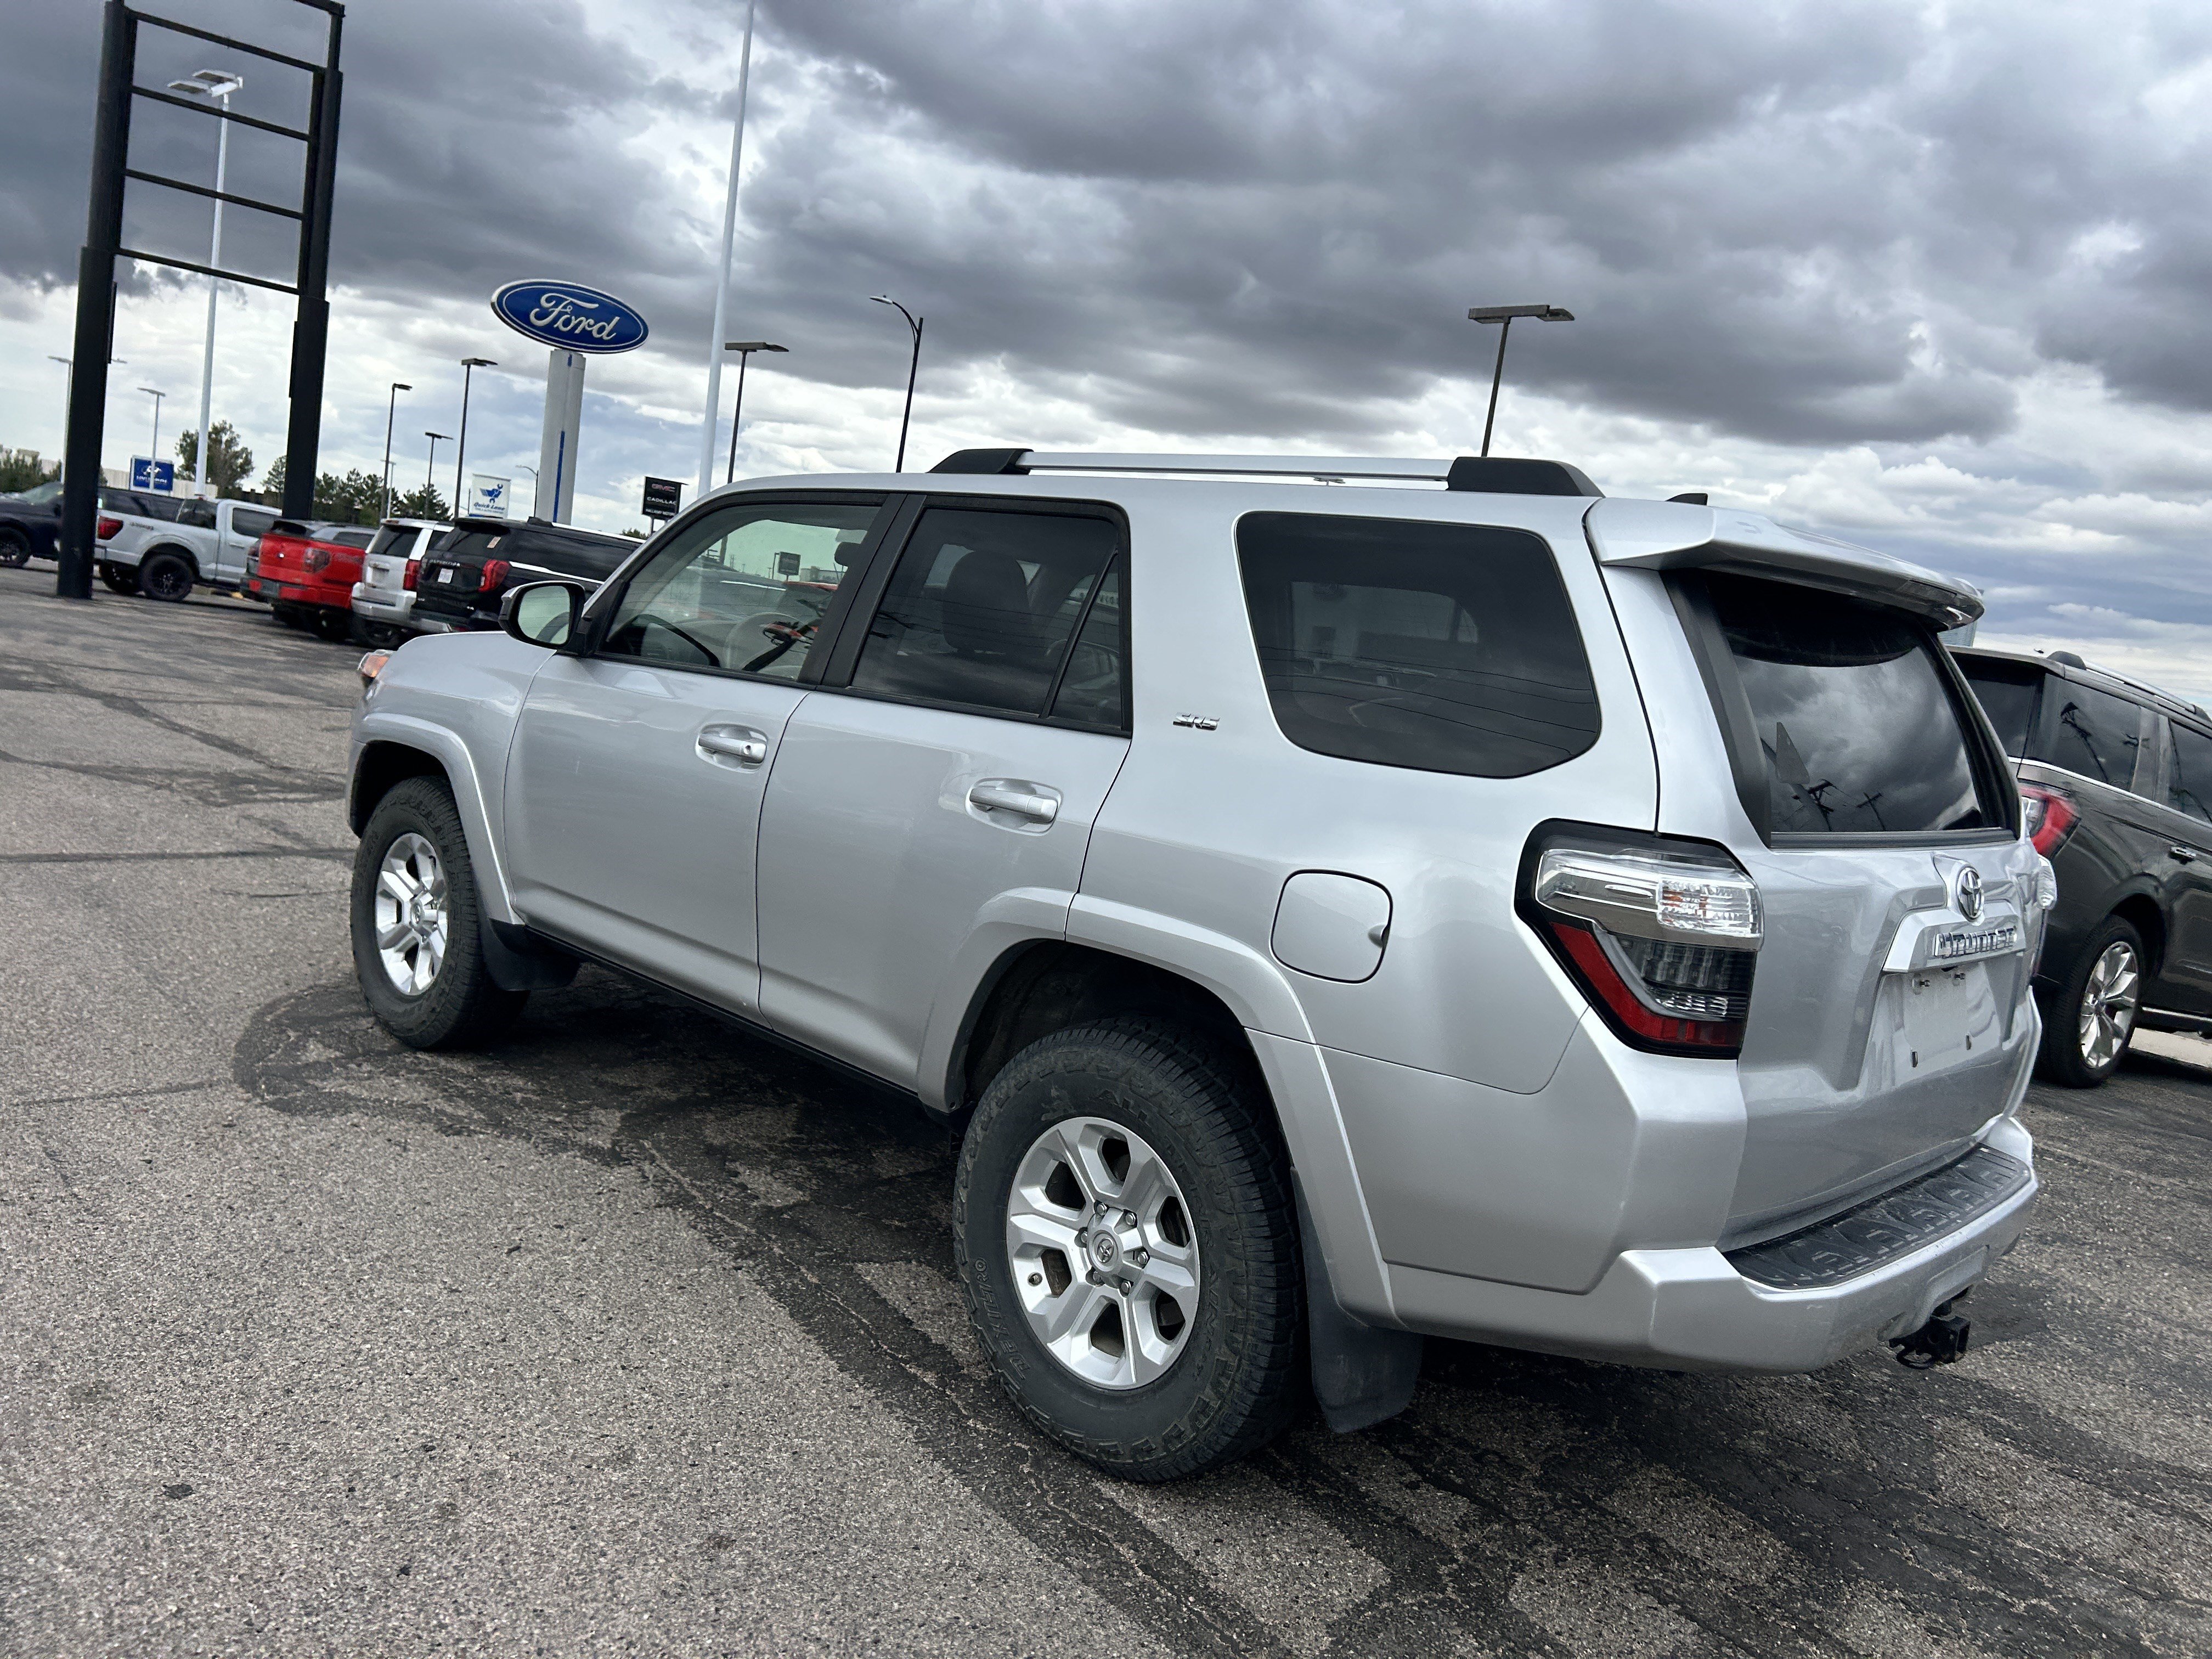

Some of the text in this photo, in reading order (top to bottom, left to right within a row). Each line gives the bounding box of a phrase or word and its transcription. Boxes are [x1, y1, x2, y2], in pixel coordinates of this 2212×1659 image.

[529, 292, 620, 340] Ford
[646, 496, 677, 505] CADILLAC
[1173, 712, 1221, 731] SR5
[974, 1257, 1031, 1380] DEXTERO
